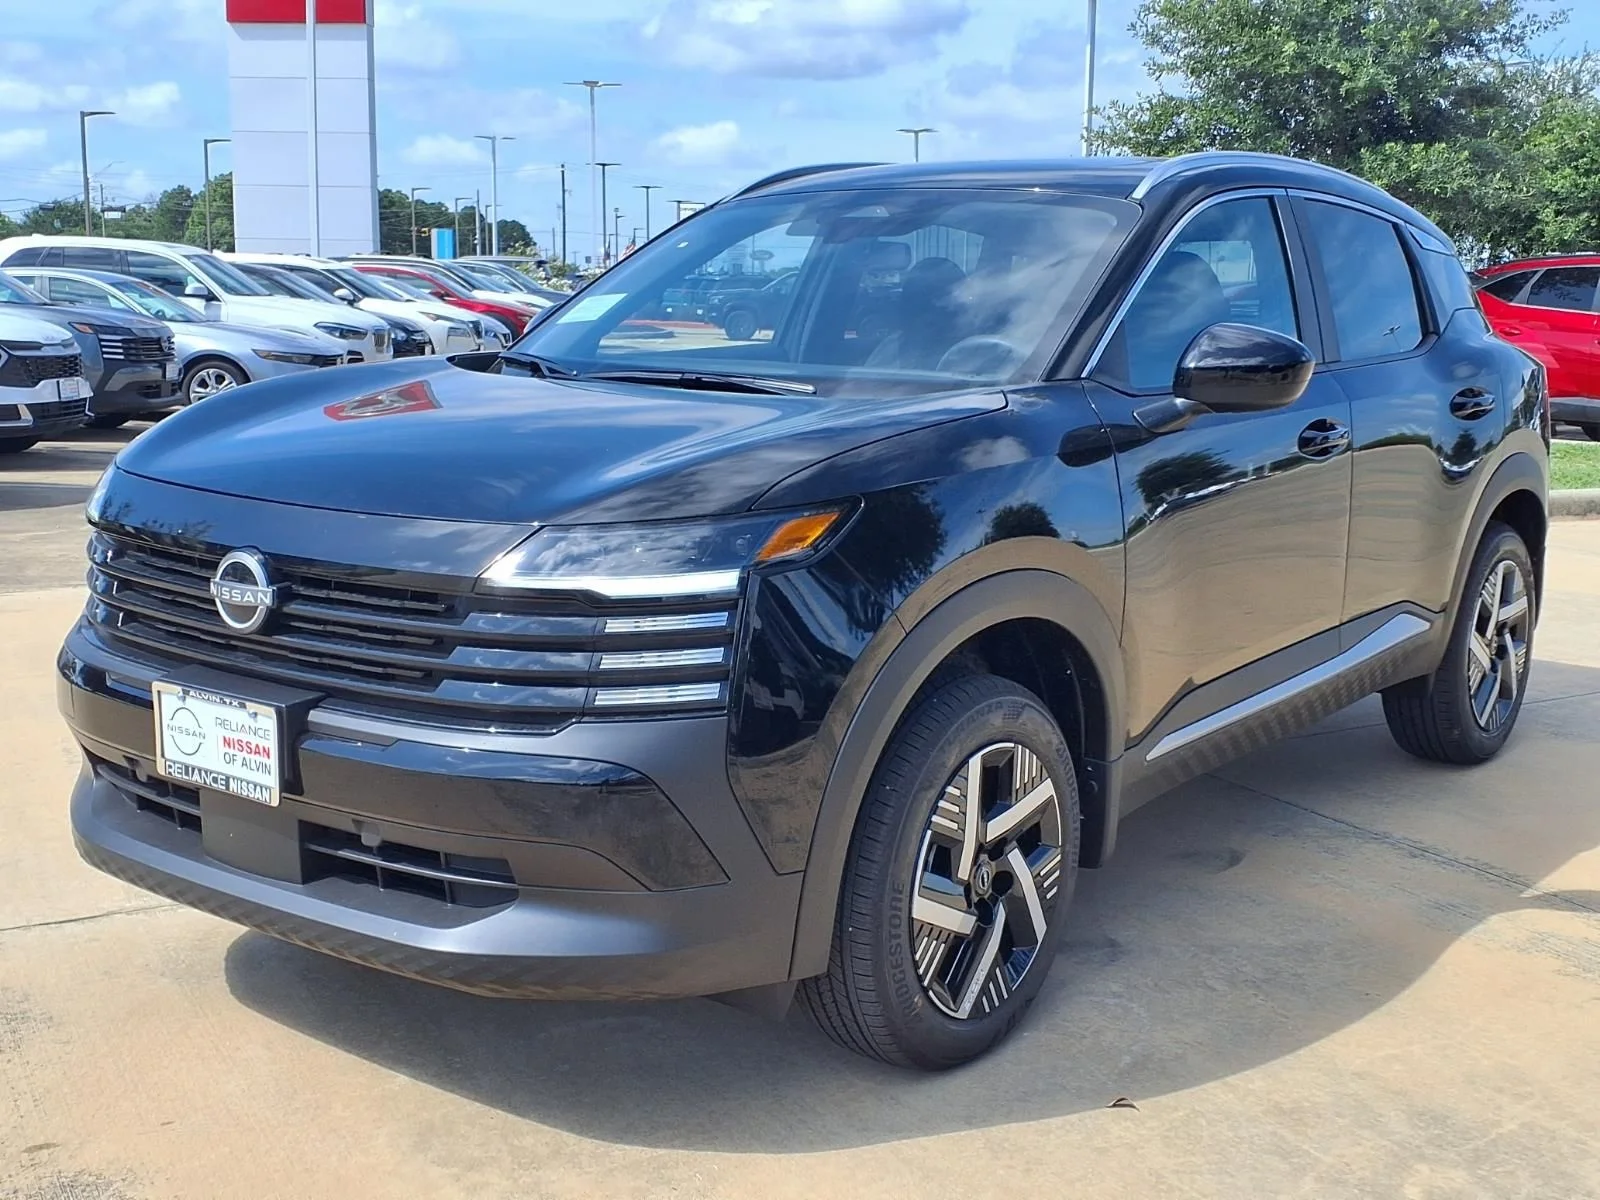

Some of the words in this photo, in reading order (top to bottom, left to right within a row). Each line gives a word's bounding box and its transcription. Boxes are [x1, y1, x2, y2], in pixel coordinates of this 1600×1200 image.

[210, 582, 270, 604] NISSAN
[167, 723, 206, 740] NISSAN
[215, 716, 271, 741] RELIANCE
[222, 735, 271, 760] NISSAN
[223, 752, 238, 766] OF
[241, 756, 272, 776] ALVIN
[166, 761, 226, 790] RELIANCE
[229, 777, 271, 803] NISSAN
